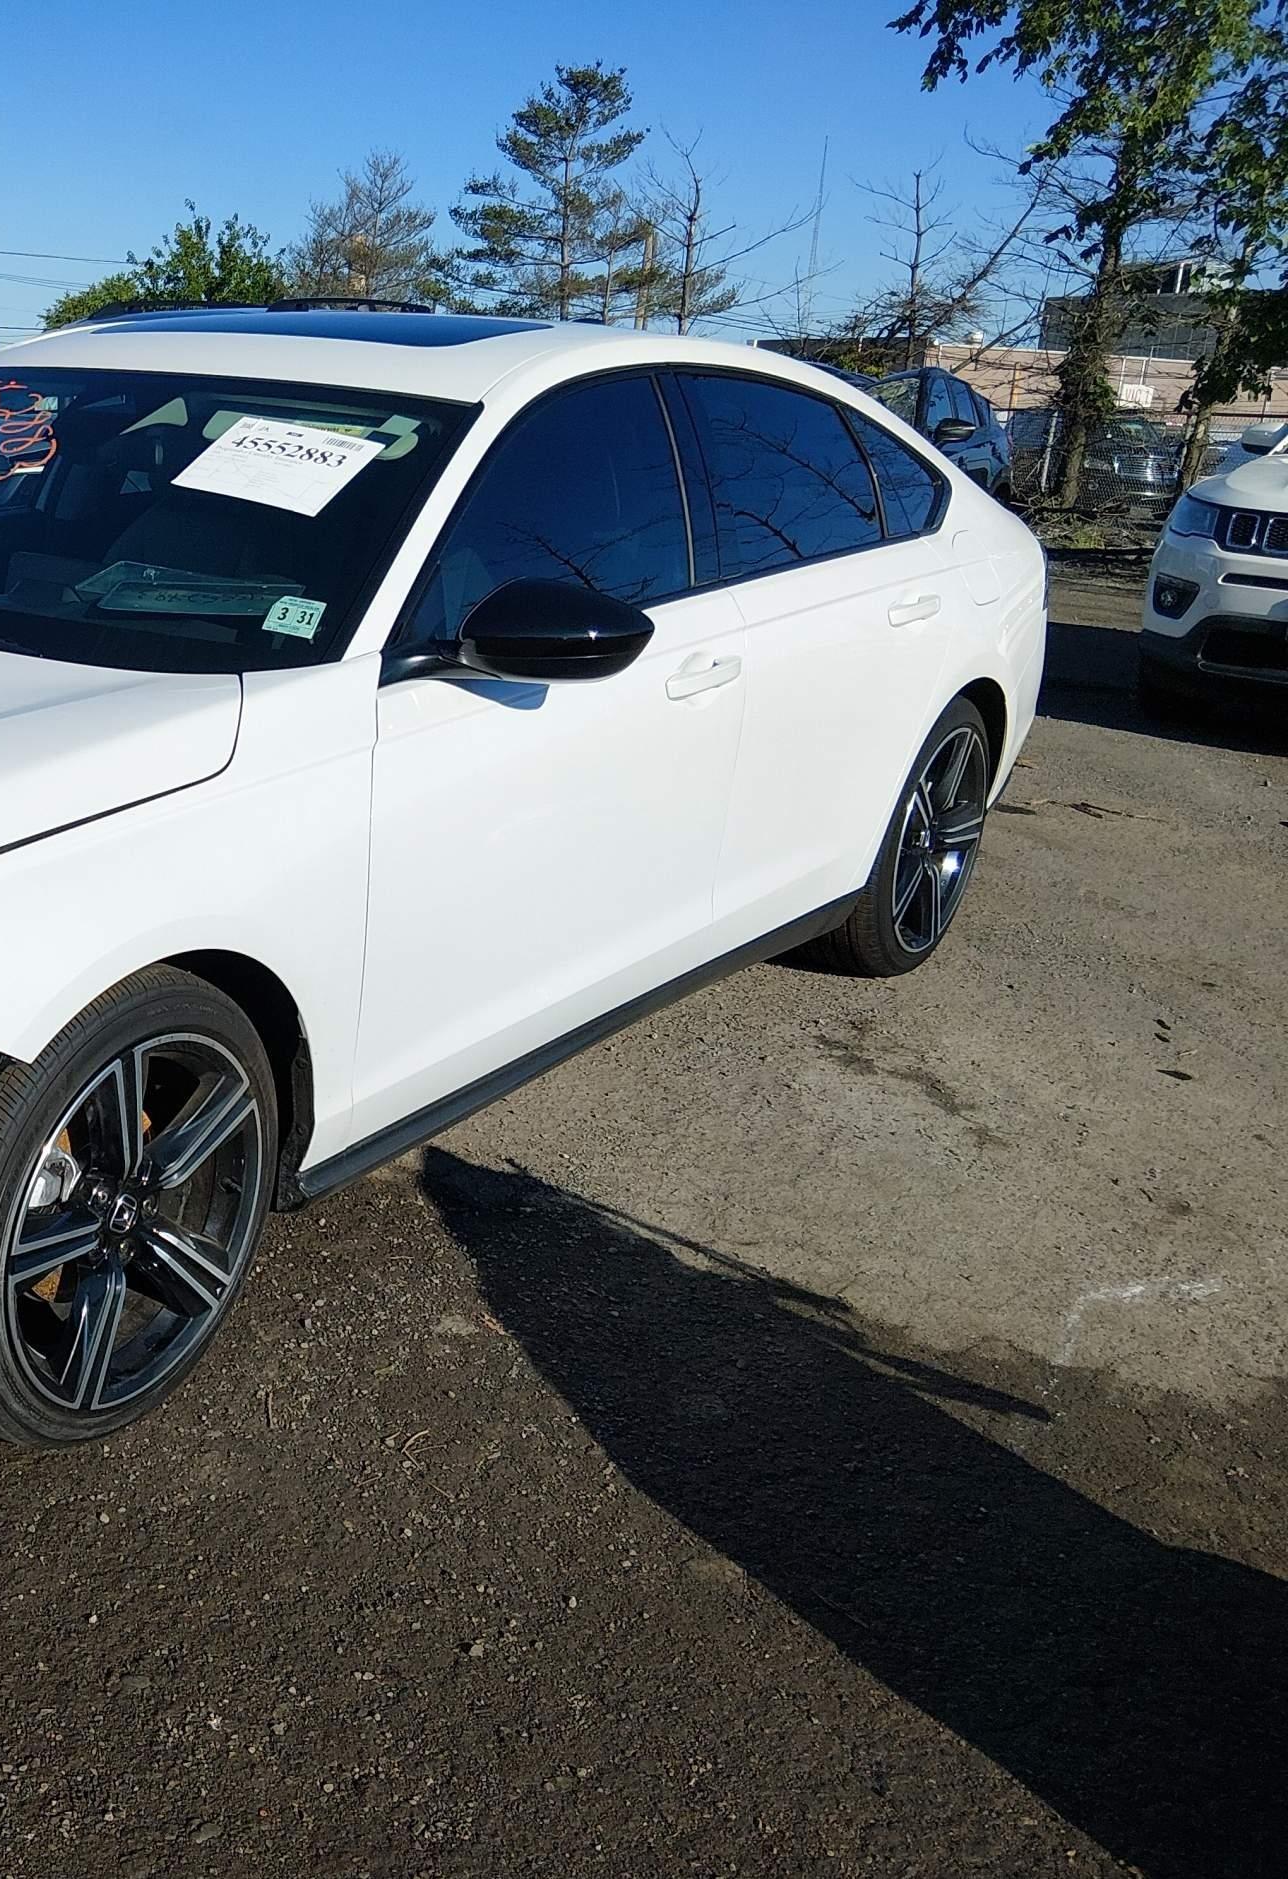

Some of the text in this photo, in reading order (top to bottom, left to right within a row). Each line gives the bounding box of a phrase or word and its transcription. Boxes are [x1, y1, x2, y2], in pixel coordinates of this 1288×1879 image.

[232, 435, 348, 468] 45552883
[277, 607, 315, 626] 3 31
